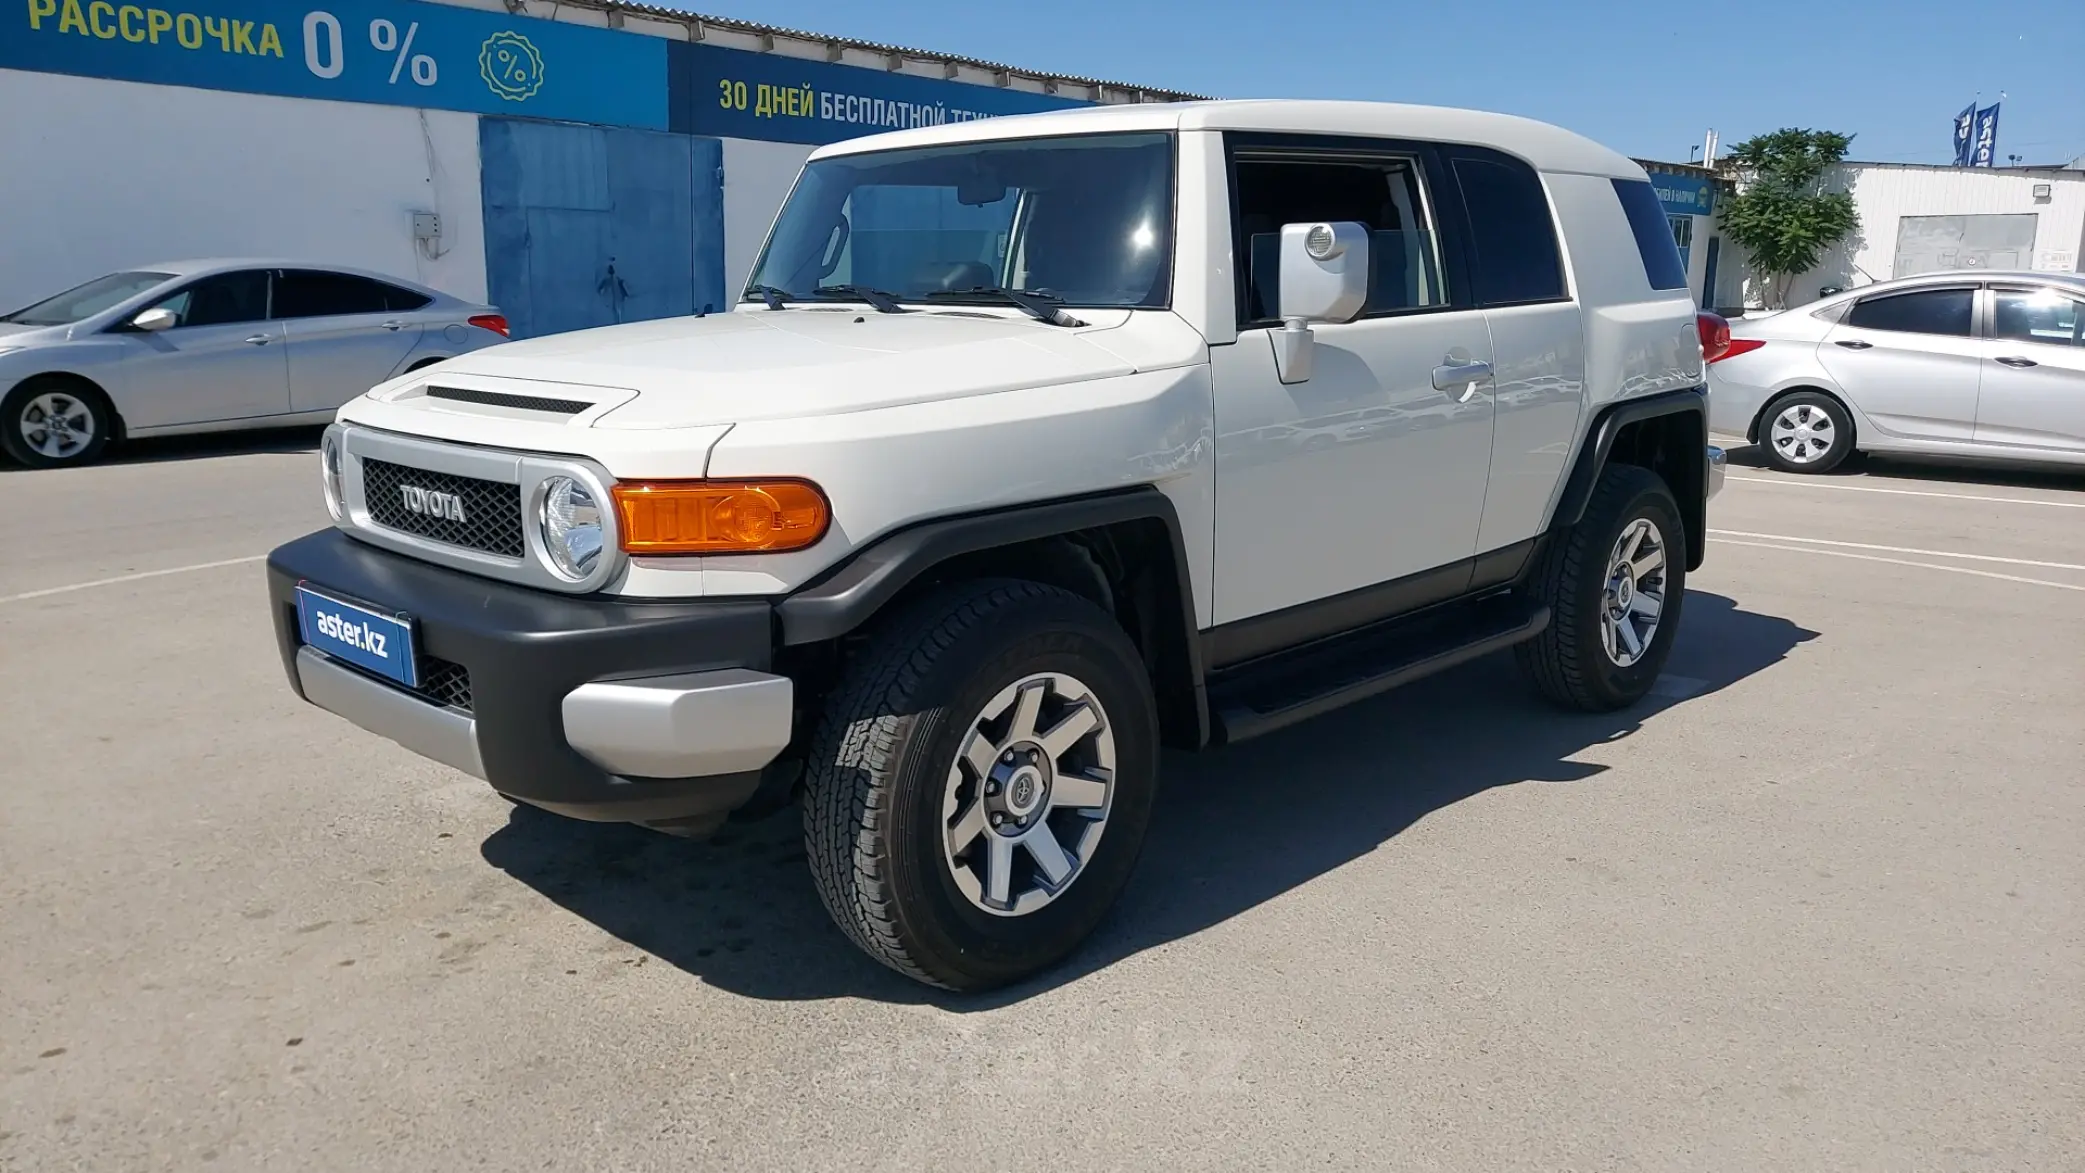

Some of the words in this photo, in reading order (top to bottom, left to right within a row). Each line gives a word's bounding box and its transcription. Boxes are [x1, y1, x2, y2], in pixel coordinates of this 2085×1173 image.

[27, 0, 284, 58] РАССРОЧКА
[303, 11, 344, 79] 0
[369, 19, 437, 86] %
[719, 79, 747, 111] 30
[755, 83, 814, 118] ДНЕЙ
[820, 91, 945, 128] БЕСПЛАТНОЙ
[400, 484, 467, 523] TOYOTA
[316, 610, 388, 658] aster.kz
